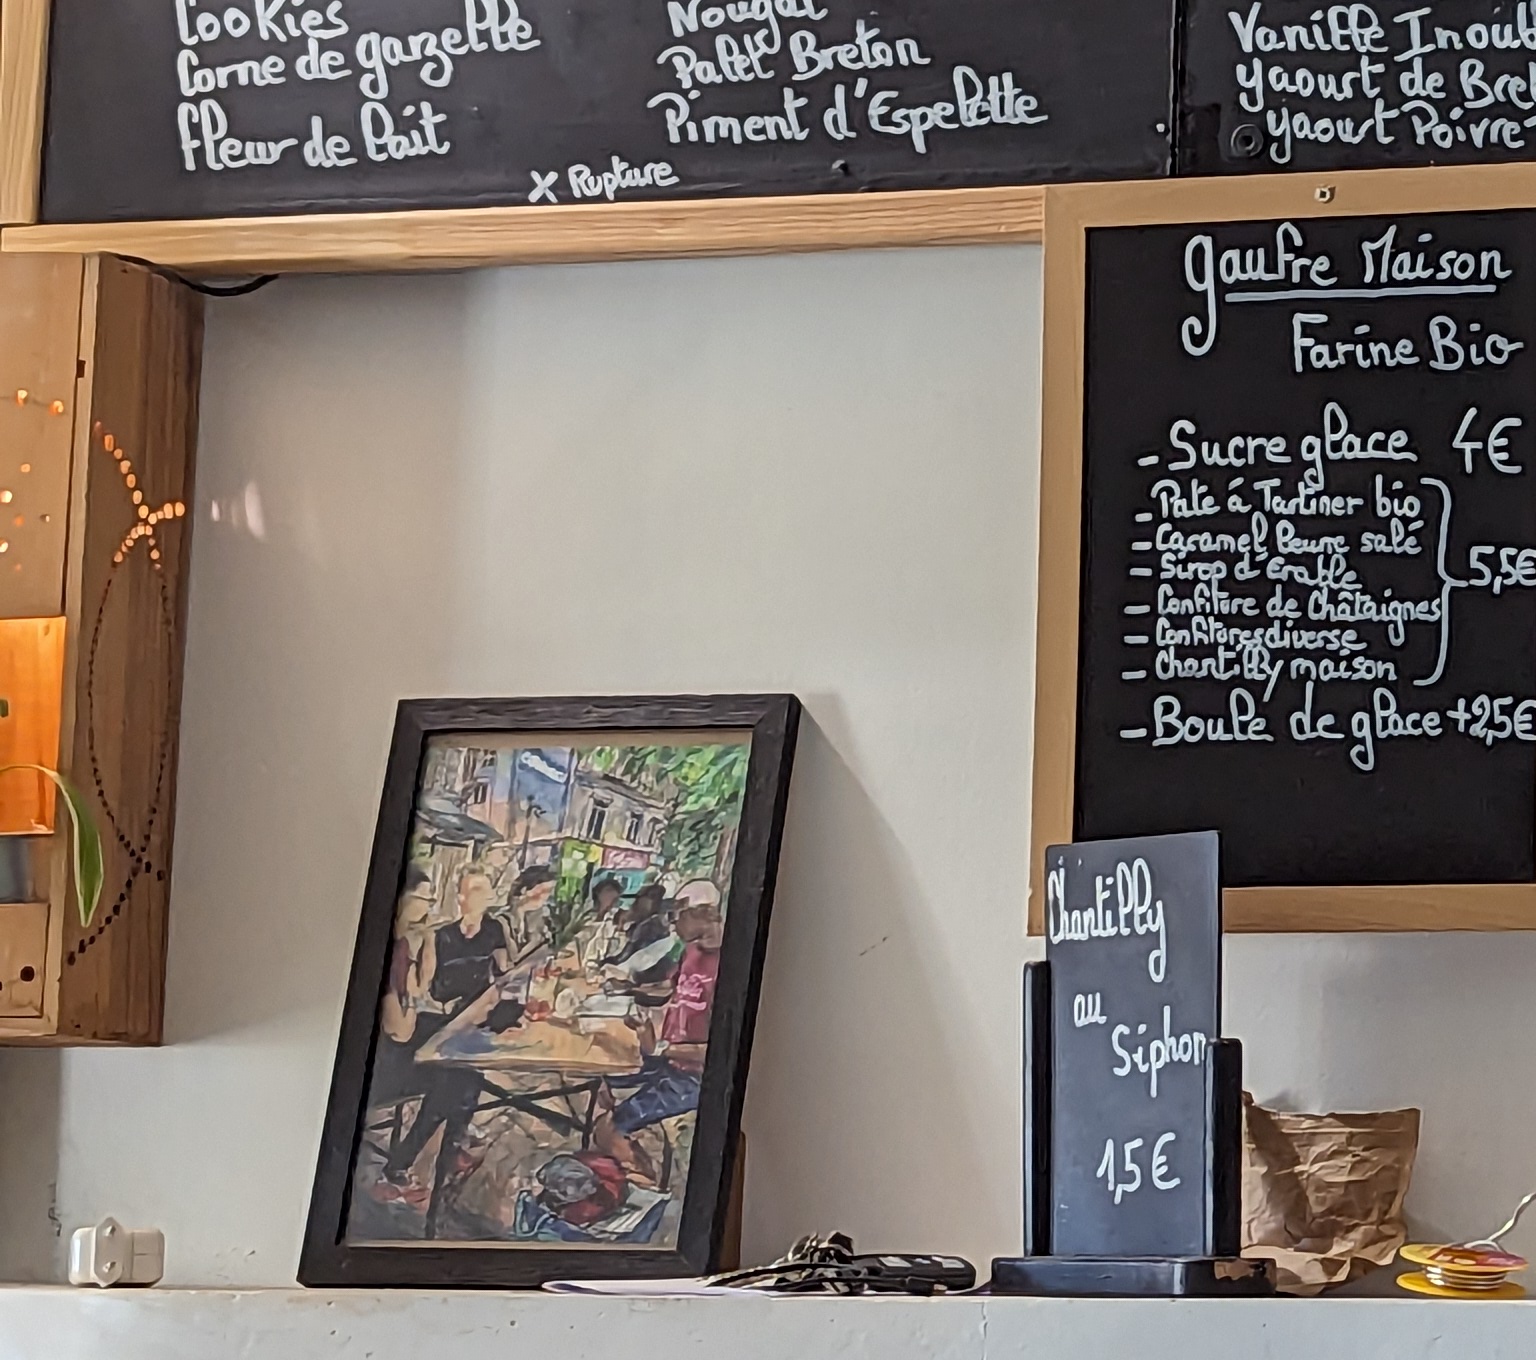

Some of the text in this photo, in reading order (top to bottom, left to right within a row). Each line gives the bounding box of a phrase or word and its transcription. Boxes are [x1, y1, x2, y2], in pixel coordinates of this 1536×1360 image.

[657, 18, 931, 90] Palet Breton
[1229, 1, 1389, 54] Vanille
[176, 48, 287, 96] Corne
[296, 38, 352, 80] de
[1399, 56, 1448, 99] de
[647, 86, 810, 145] Piment
[303, 116, 357, 169] de
[569, 155, 679, 200] Rupture
[1361, 224, 1512, 285] Maison
[1293, 313, 1524, 373] Farine Bio
[1168, 402, 1416, 488] Sucre glace
[1253, 474, 1421, 518] Tartiner bio
[1156, 511, 1268, 553] Caramel
[1160, 551, 1227, 593] Sirop
[1158, 583, 1260, 616] Confiture
[1266, 584, 1302, 619] de
[1153, 681, 1443, 771] Boule de glace
[1073, 992, 1106, 1028] au
